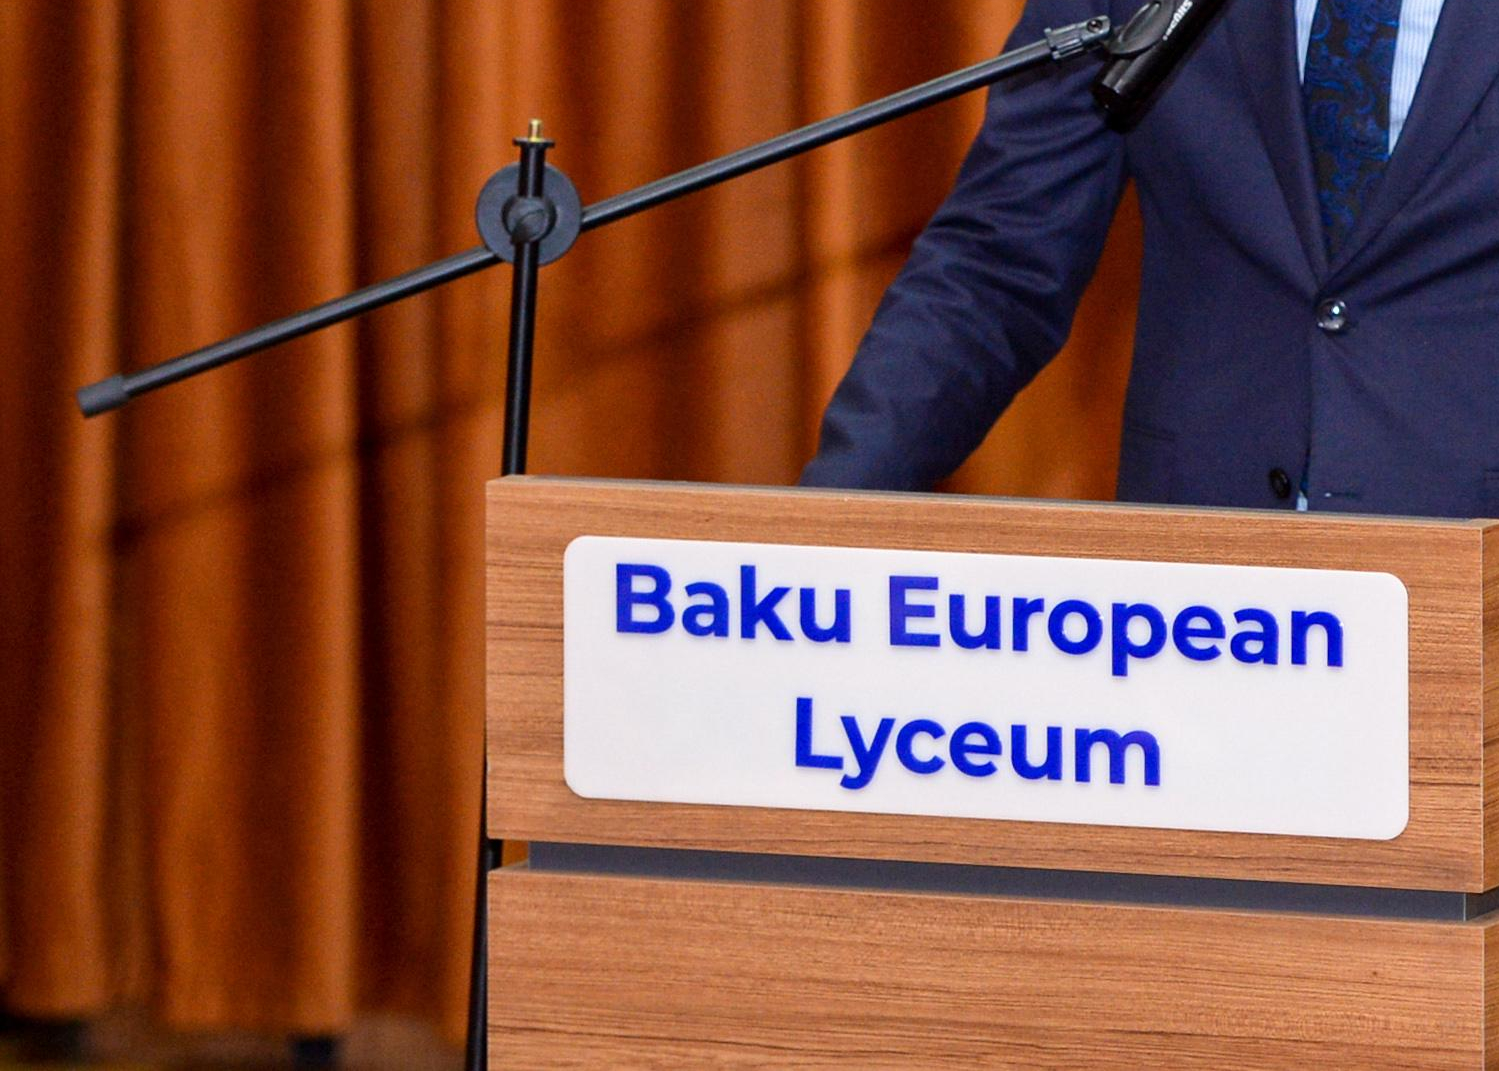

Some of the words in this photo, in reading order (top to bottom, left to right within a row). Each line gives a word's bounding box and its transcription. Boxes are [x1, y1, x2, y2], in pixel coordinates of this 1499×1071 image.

[614, 561, 852, 644] Baku
[888, 574, 1345, 678] European
[794, 696, 1161, 791] Lyceum
